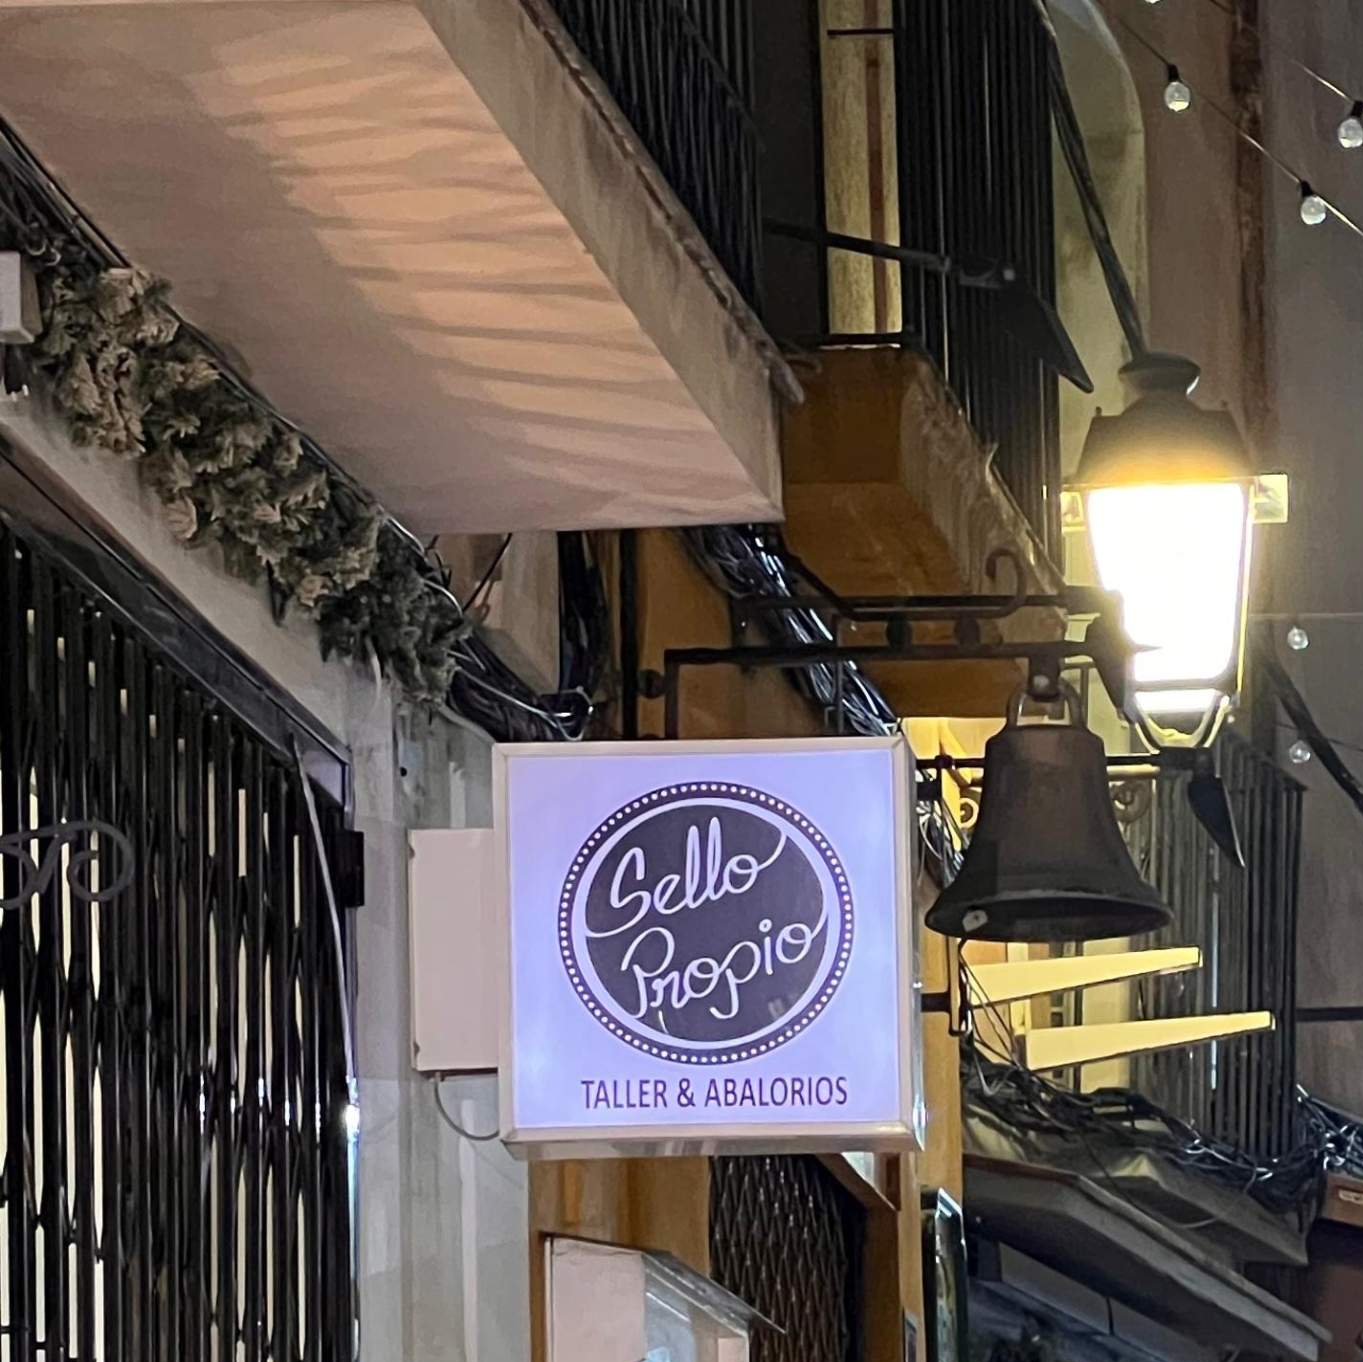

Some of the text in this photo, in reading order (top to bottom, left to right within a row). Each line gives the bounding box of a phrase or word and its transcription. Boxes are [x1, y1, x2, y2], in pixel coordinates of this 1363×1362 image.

[585, 816, 787, 938] Sello
[620, 918, 828, 1021] Propio
[581, 1075, 849, 1110] TALLER & ABALORIOS
